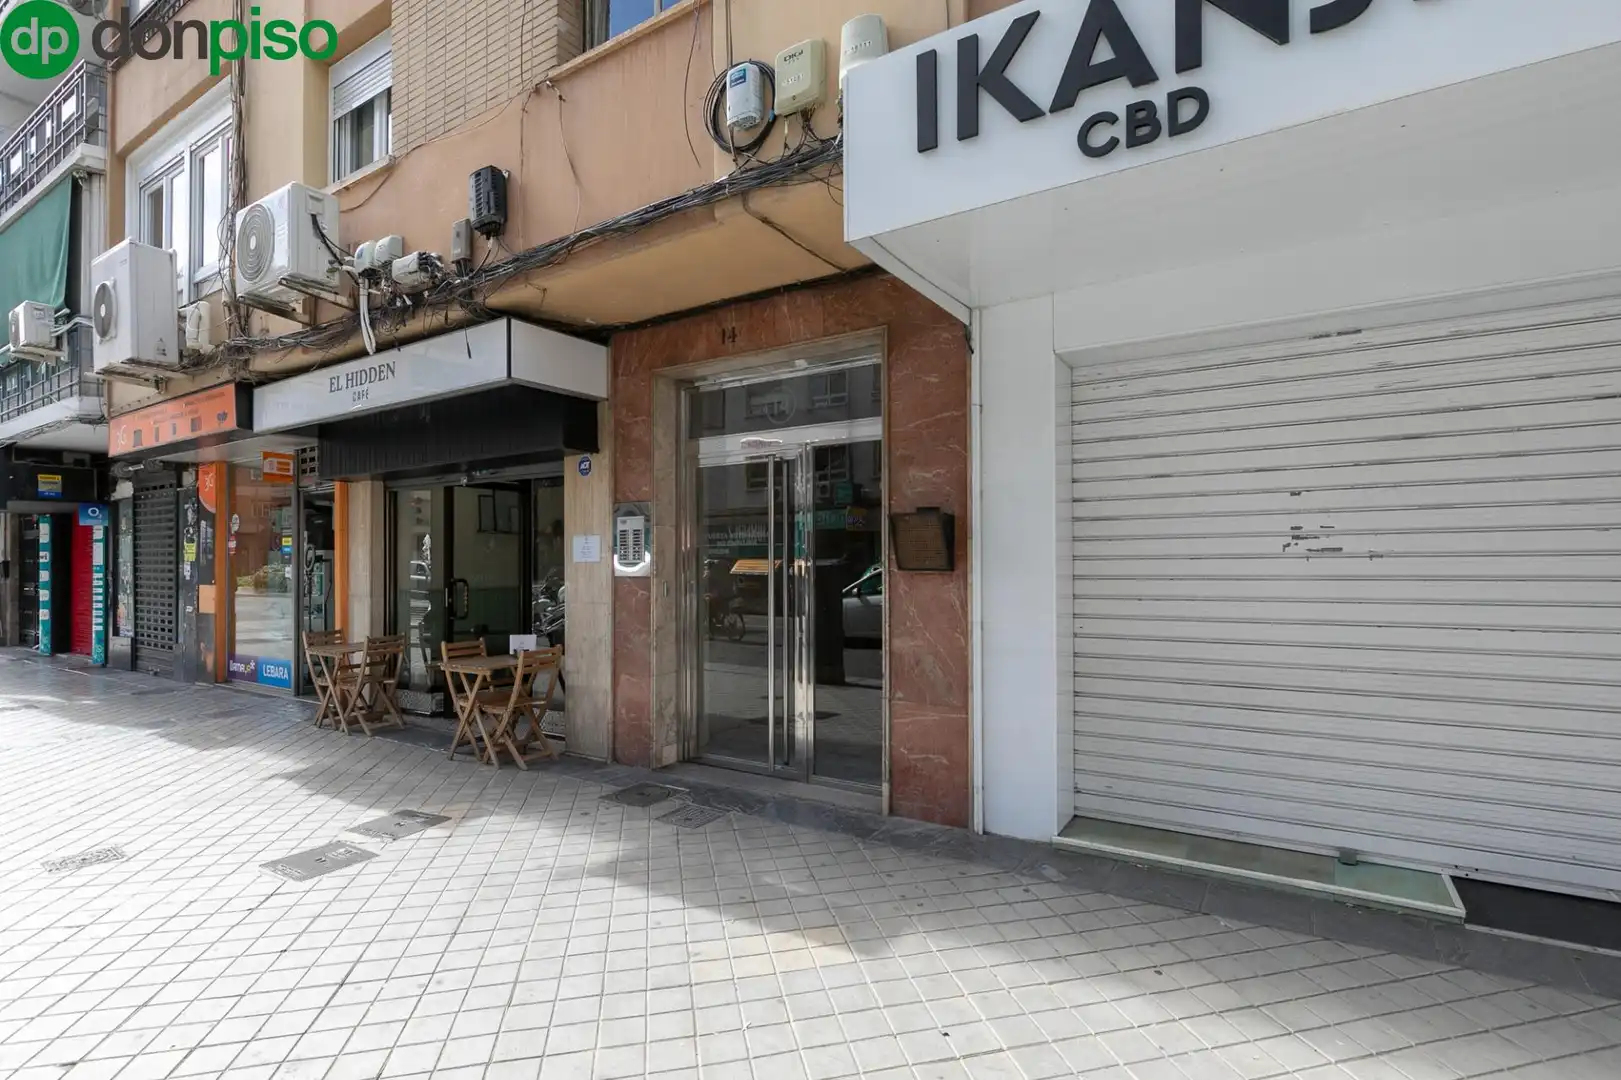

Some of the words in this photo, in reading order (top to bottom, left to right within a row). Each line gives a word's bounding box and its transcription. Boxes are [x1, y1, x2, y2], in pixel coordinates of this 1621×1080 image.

[917, 0, 1438, 153] IKAN
[1077, 86, 1210, 158] CBD
[722, 326, 737, 344] 14
[329, 375, 343, 393] EL
[345, 360, 396, 389] HIDDEN
[262, 664, 289, 681] LEBARA
